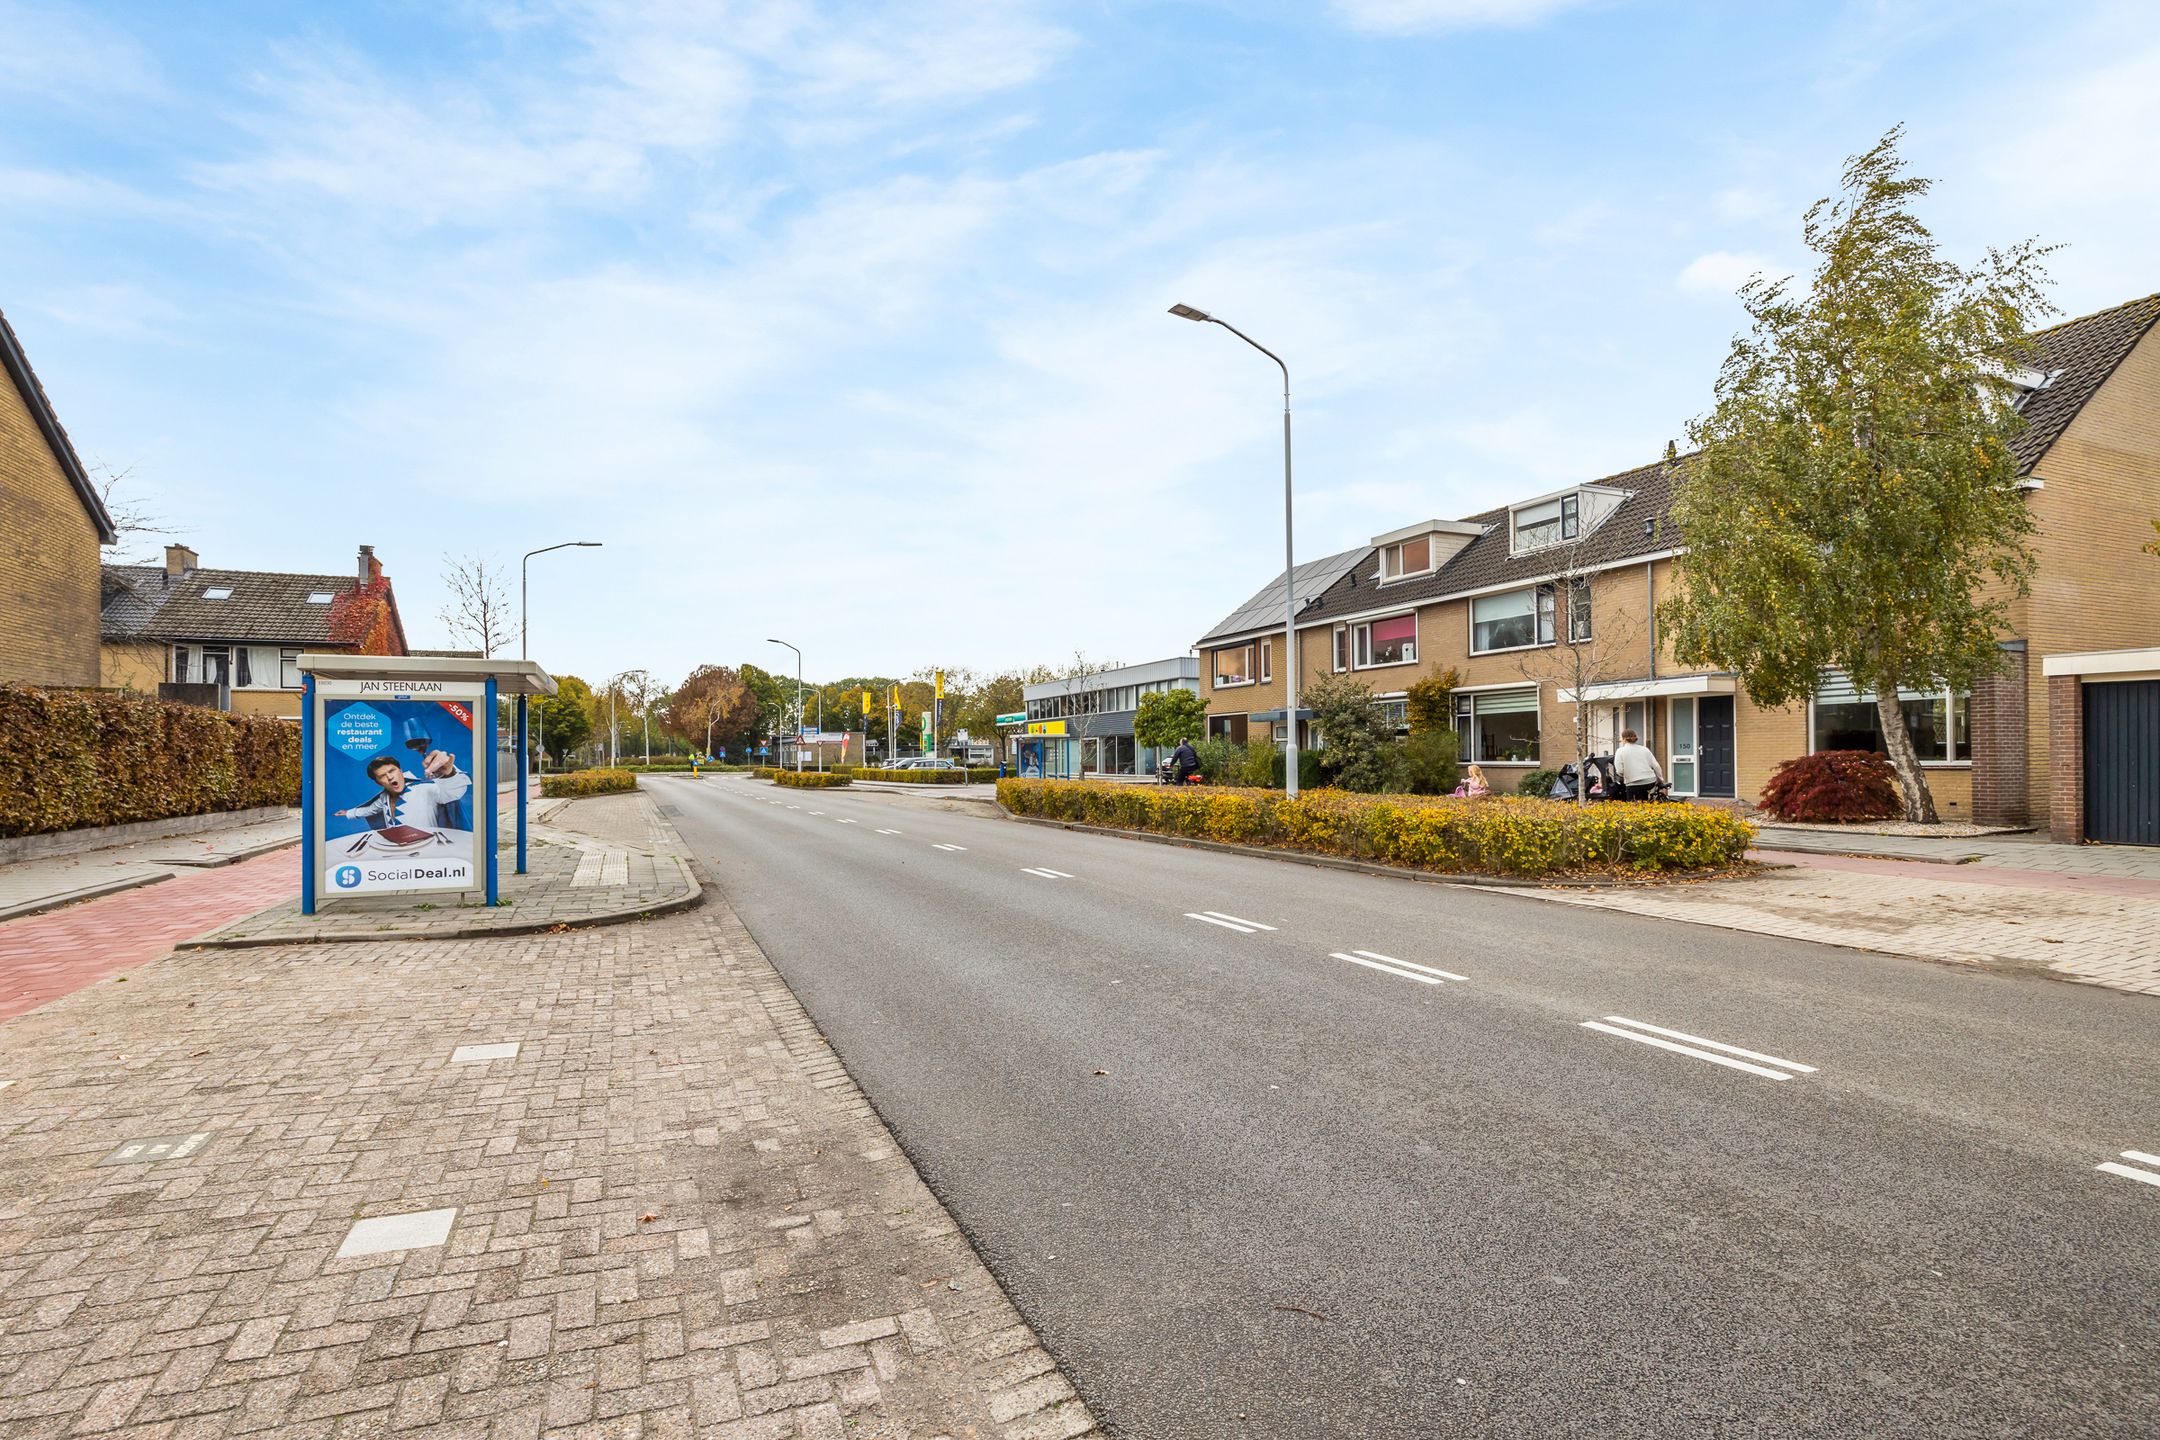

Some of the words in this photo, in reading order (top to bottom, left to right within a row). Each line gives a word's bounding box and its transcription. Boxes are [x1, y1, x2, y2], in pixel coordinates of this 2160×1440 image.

[360, 681, 380, 693] JAN
[383, 682, 442, 692] STEENLAAN
[343, 712, 376, 720] Ontdek
[449, 704, 469, 721] -50%
